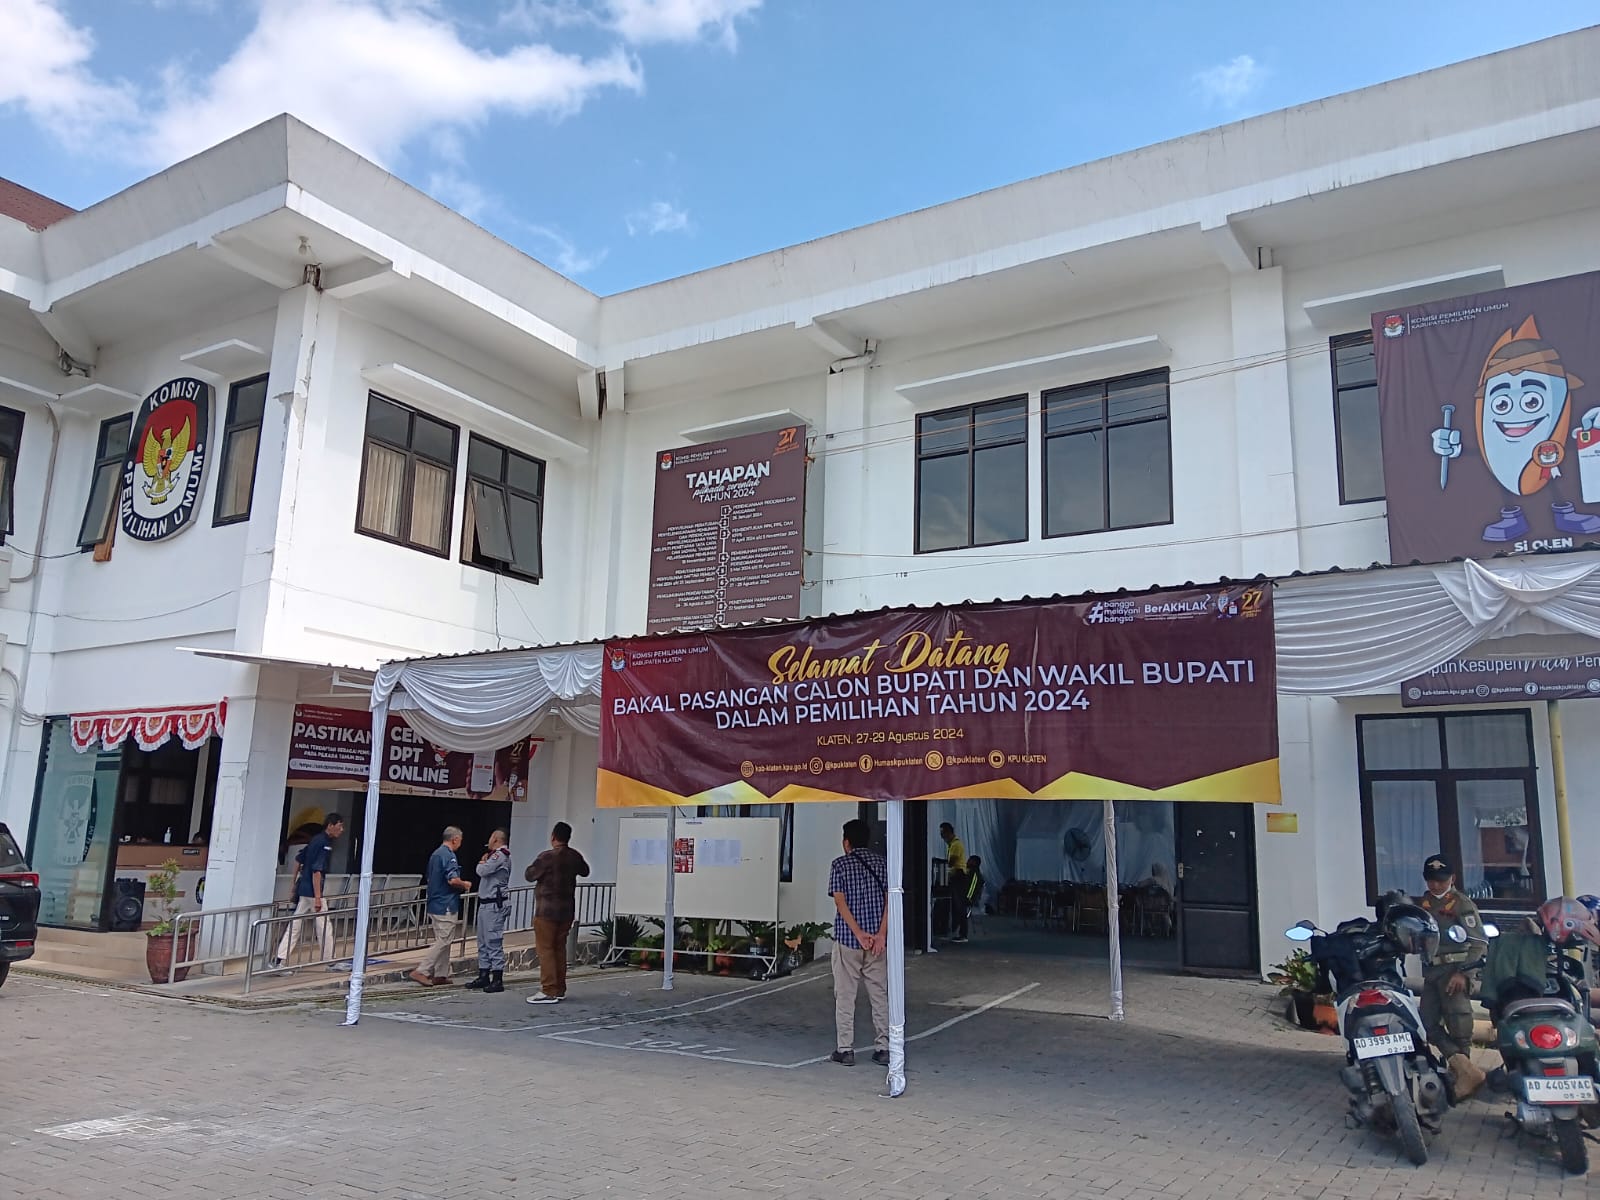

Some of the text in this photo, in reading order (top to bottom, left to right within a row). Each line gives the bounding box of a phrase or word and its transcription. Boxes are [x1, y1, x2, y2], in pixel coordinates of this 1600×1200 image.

[1411, 303, 1509, 324] KOMISI PEMILIHAN UMUM
[150, 381, 200, 411] KOMISI
[779, 428, 797, 447] 27
[686, 460, 770, 489] TAHAPAN
[122, 455, 203, 539] PEMILIHAN UMUM
[699, 487, 756, 503] TAHUN 2024
[1514, 540, 1529, 552] Si
[1104, 601, 1135, 609] bangga
[1145, 601, 1207, 614] BerAKHLAK
[1242, 591, 1263, 611] 27
[1104, 607, 1141, 616] melayani
[1104, 615, 1134, 624] bangsa
[654, 647, 687, 657] PEMILIHAN
[689, 645, 709, 653] UMUM
[767, 631, 1011, 686] Selamat Datang
[662, 656, 682, 664] KLATEN
[1428, 662, 1457, 678] pun
[1459, 659, 1521, 675] Kesupen
[613, 660, 1255, 716] BAKAL PASANGAN CALON BUPATI DAN WAKIL BUPATI
[716, 689, 1090, 730] DALAM PEMILIHAN TAHUN 2024
[856, 731, 886, 744] 27-29
[888, 730, 930, 744] Agustus
[933, 728, 964, 740] 2024
[389, 745, 423, 762] DPT
[755, 762, 807, 772] kab-klaten.kpu.go.id
[825, 760, 857, 770] @kpuklaten
[946, 755, 986, 766] @kpuklaten
[1008, 754, 1021, 763] KPU
[1021, 754, 1047, 763] KLATEN
[388, 764, 449, 784] ONLINE
[1355, 1033, 1411, 1049] AD 3999 AMC
[1528, 1080, 1541, 1090] AD
[1546, 1080, 1570, 1090] 4405
